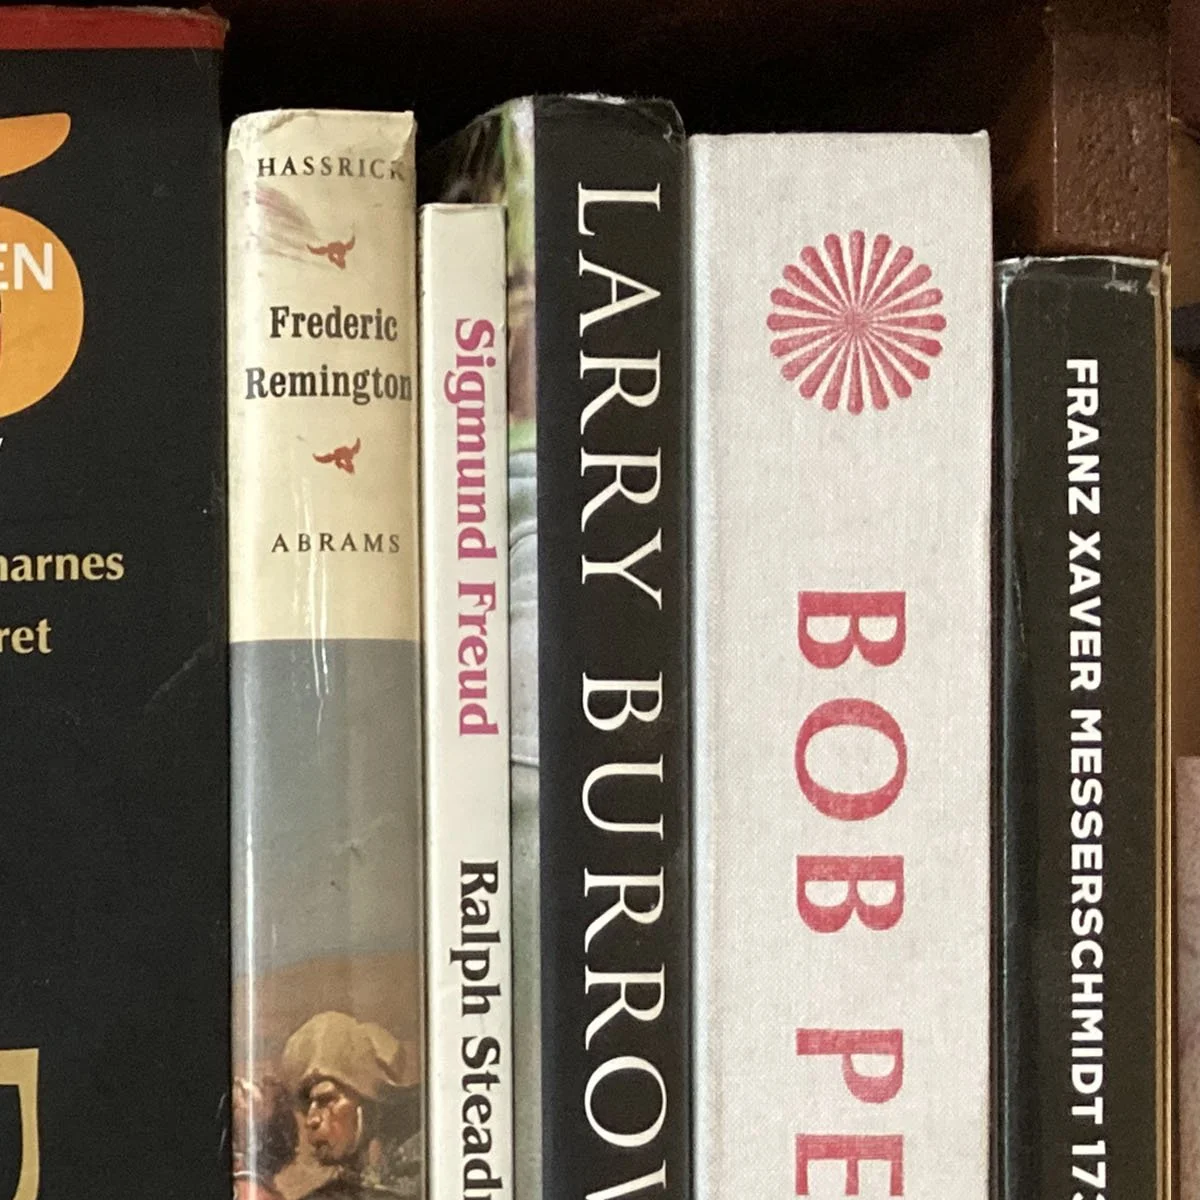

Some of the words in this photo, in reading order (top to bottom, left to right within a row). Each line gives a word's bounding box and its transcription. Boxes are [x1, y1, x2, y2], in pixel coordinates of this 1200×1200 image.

[244, 364, 412, 405] Remington
[269, 306, 398, 341] Frederic
[577, 182, 663, 611] LARRY
[443, 318, 498, 561] Sigmund
[1062, 358, 1099, 516] FRANZ
[271, 532, 401, 554] ABRAMS
[1067, 530, 1103, 692] XAVER
[457, 582, 500, 737] Freud
[793, 590, 909, 934] BOB
[449, 860, 500, 1018] Ralph
[1068, 709, 1106, 1124] MESSERSCHMIDT
